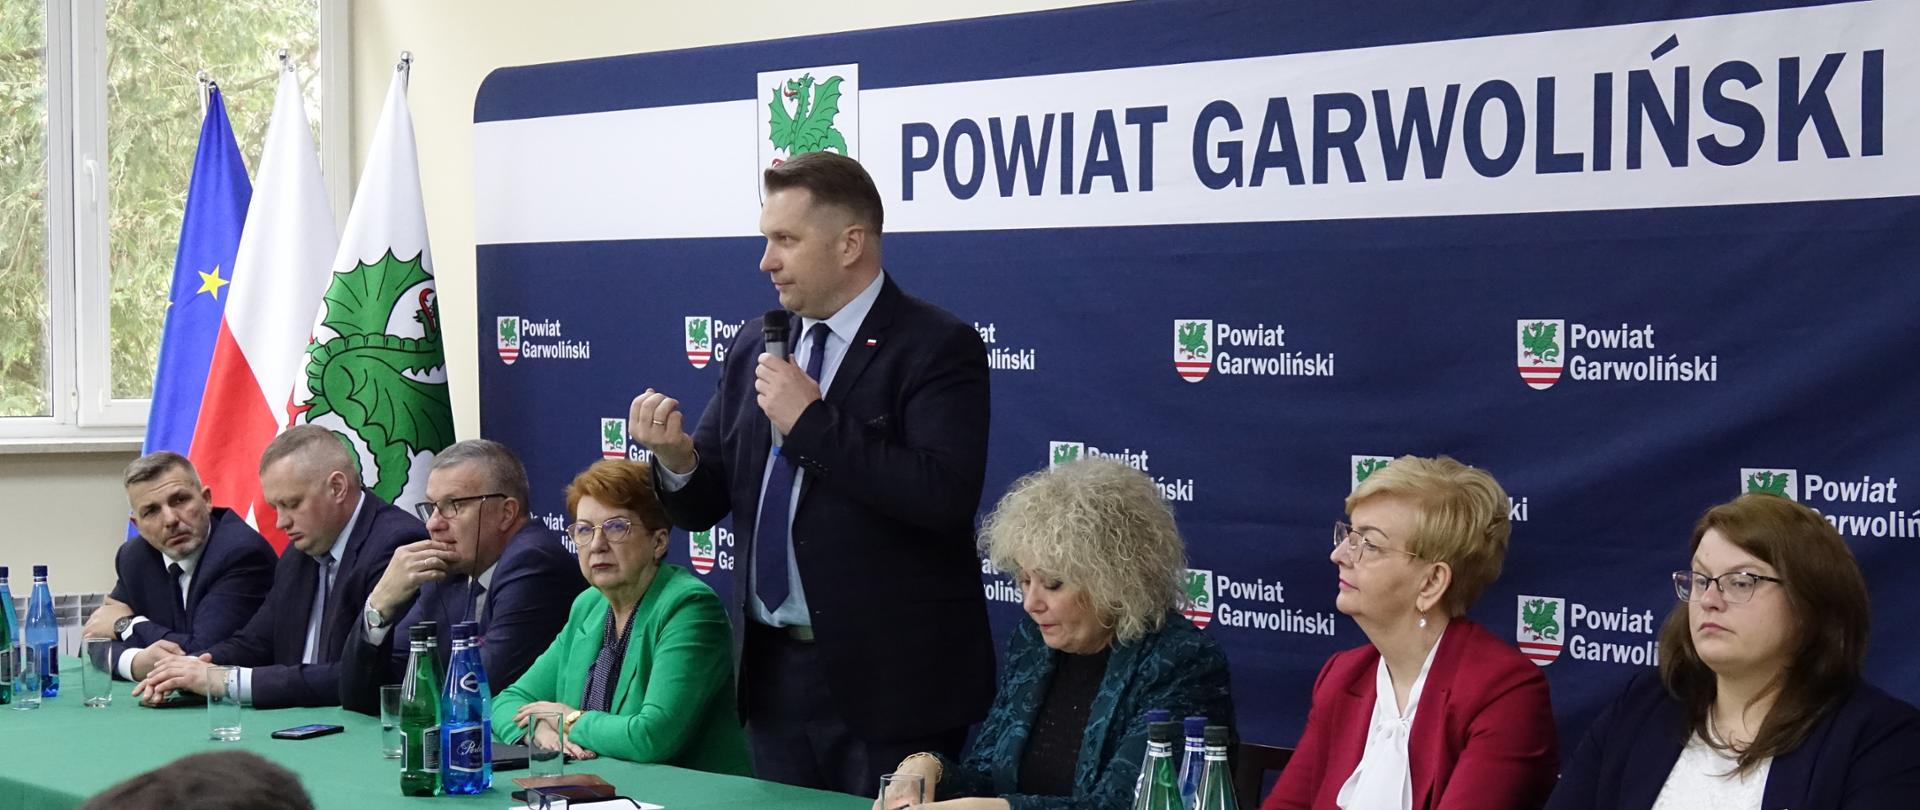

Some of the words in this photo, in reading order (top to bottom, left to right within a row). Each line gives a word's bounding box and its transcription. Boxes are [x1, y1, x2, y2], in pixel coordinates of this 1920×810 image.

[901, 105, 1168, 201] POWIAT
[1192, 33, 1885, 190] GARWOLIŃSKI
[521, 318, 562, 337] Powiat
[1217, 323, 1285, 347] Powiat
[1571, 323, 1655, 349] Powiat
[521, 339, 590, 359] Garwoliński
[1216, 351, 1334, 377] Garwoliński
[1570, 353, 1718, 382] Garwoliński
[1805, 474, 1898, 504] Powiat
[1217, 575, 1285, 603] Powiat
[1218, 603, 1335, 636] Garwoliński
[1571, 603, 1654, 634] Powiat
[1569, 634, 1659, 666] Garwoli
